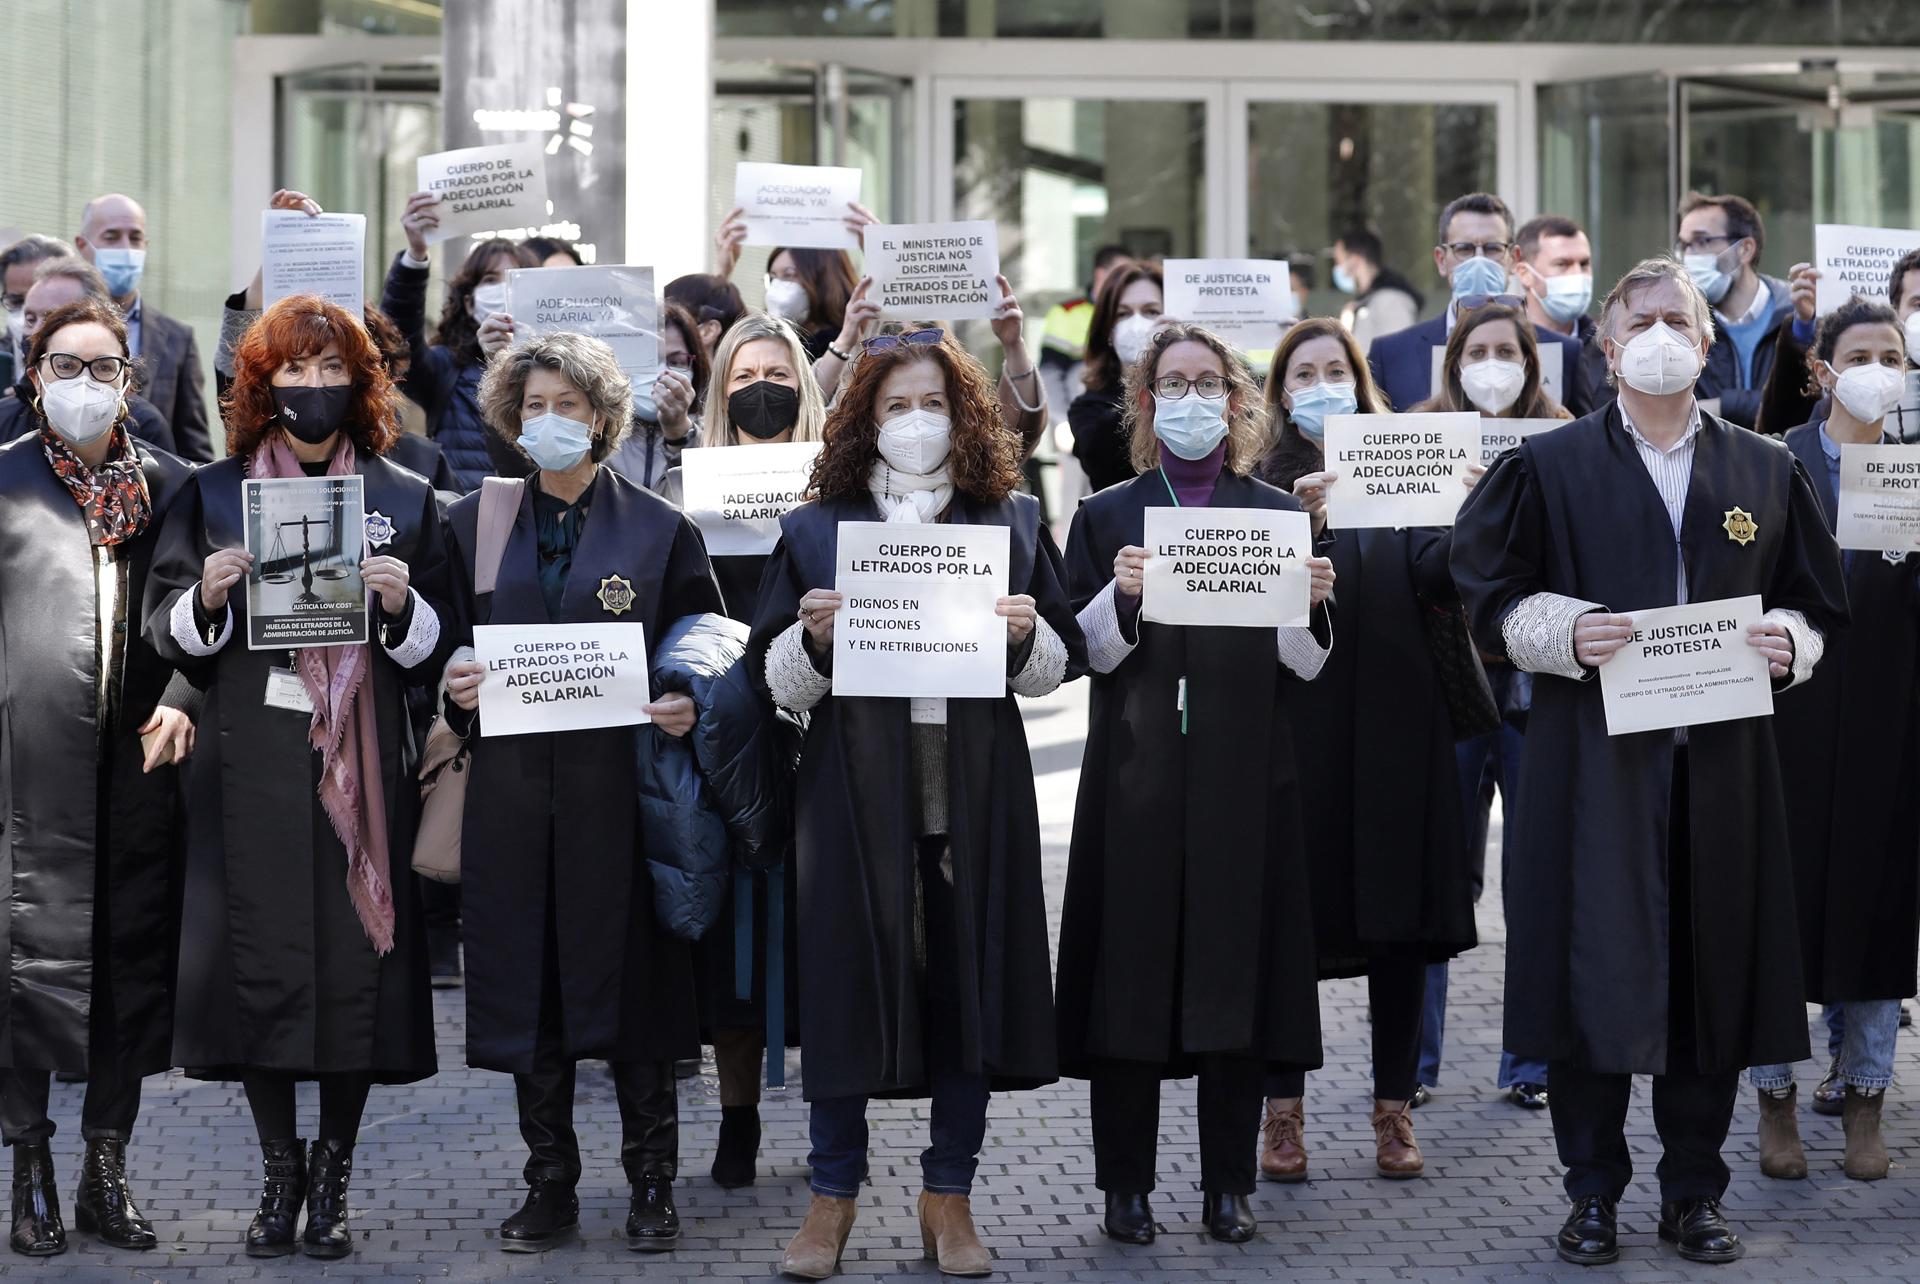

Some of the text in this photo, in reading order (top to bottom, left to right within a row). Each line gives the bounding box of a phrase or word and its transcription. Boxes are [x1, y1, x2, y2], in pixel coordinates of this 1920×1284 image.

[447, 159, 512, 175] CUERPO DE
[429, 169, 534, 190] LETRADOS POR LA
[441, 182, 524, 201] ADECUACIÓN
[452, 198, 515, 213] SALARIAL
[756, 196, 806, 207] SALARIAL
[883, 236, 983, 250] EL MINISTERIO DE
[896, 250, 972, 262] JUSTICIA NOS
[1847, 246, 1895, 257] CUERPO
[902, 263, 967, 274] DISCRIMINA
[1827, 258, 1889, 268] LETRADOS
[1185, 274, 1271, 284] DE JUSTICIA EN
[883, 279, 988, 293] LETRADOS DE LA
[1199, 286, 1259, 296] PROTESTA
[883, 291, 988, 306] ADMINISTRACIÓN
[537, 311, 595, 323] SALARIAL
[1363, 433, 1442, 445] CUERPO DE
[1339, 449, 1412, 461] LETRADOS
[1417, 448, 1445, 460] POR
[1449, 448, 1467, 459] LA
[1353, 462, 1453, 478] ADECUACIÓN
[1866, 462, 1885, 473] DE
[1366, 481, 1440, 495] SALARIAL
[723, 508, 787, 520] SALARIA
[1185, 528, 1271, 541] CUERPO DE
[879, 544, 967, 558] CUERPO DE
[1159, 545, 1296, 559] LETRADOS POR LA
[851, 560, 993, 576] LETRADOS POR LA
[1172, 560, 1281, 576] ADECUACIÓN
[1186, 579, 1267, 594] SALARIAL
[850, 598, 919, 610] DIGNOS EN
[301, 621, 332, 629] LETRADOS
[849, 618, 921, 631] FUNCIONES
[1648, 622, 1713, 641] JUSTICIA
[1717, 618, 1737, 632] EN
[263, 630, 317, 638] ADMINISTRACIÓN
[327, 628, 354, 636] JUSTICIA
[514, 640, 600, 653] CUERPO DE
[848, 640, 978, 653] Y EN RETRIBUCIONES
[1643, 638, 1722, 658] PROTESTA
[489, 651, 629, 671] LETRADOS POR LA
[506, 664, 616, 687] ADECUACIÓN
[1619, 690, 1644, 699] CUERPO
[1654, 685, 1685, 695] LETRADOS
[1704, 676, 1754, 688] ADMINISTRACIÓN
[1679, 690, 1705, 698] JUSTICIA
[521, 685, 604, 704] SALARIAL
